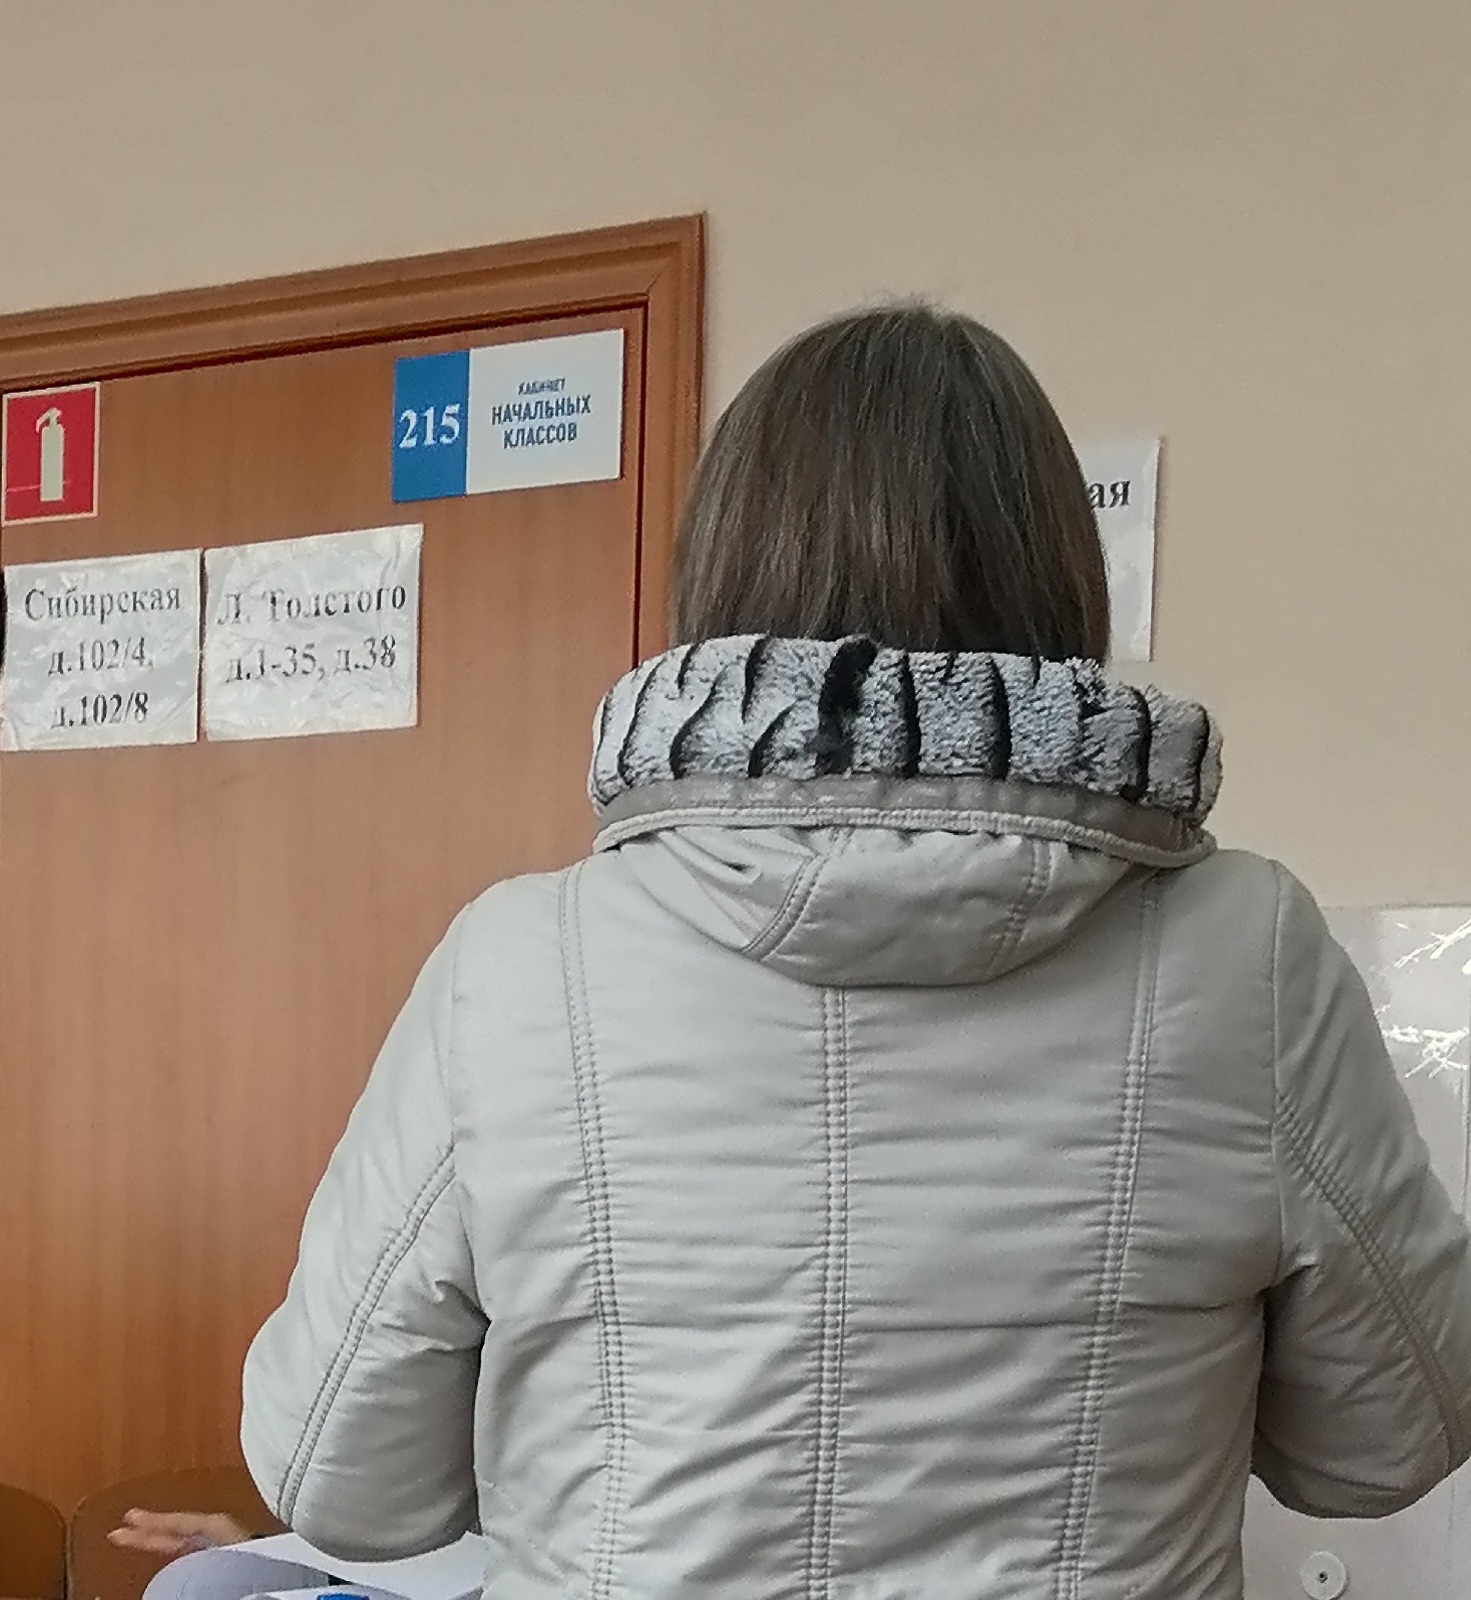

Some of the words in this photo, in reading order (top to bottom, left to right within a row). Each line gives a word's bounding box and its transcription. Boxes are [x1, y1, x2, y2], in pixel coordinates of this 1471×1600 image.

[398, 403, 461, 449] 215
[491, 394, 592, 426] НАЧАЛЬНЫХ
[503, 422, 578, 450] КЛАССОВ
[24, 586, 181, 626] Сибирская
[216, 592, 252, 626] Л.
[262, 584, 407, 623] Толстого
[47, 635, 155, 679] д.102/4,
[334, 634, 397, 677] д.38
[49, 690, 149, 731] д.102/8
